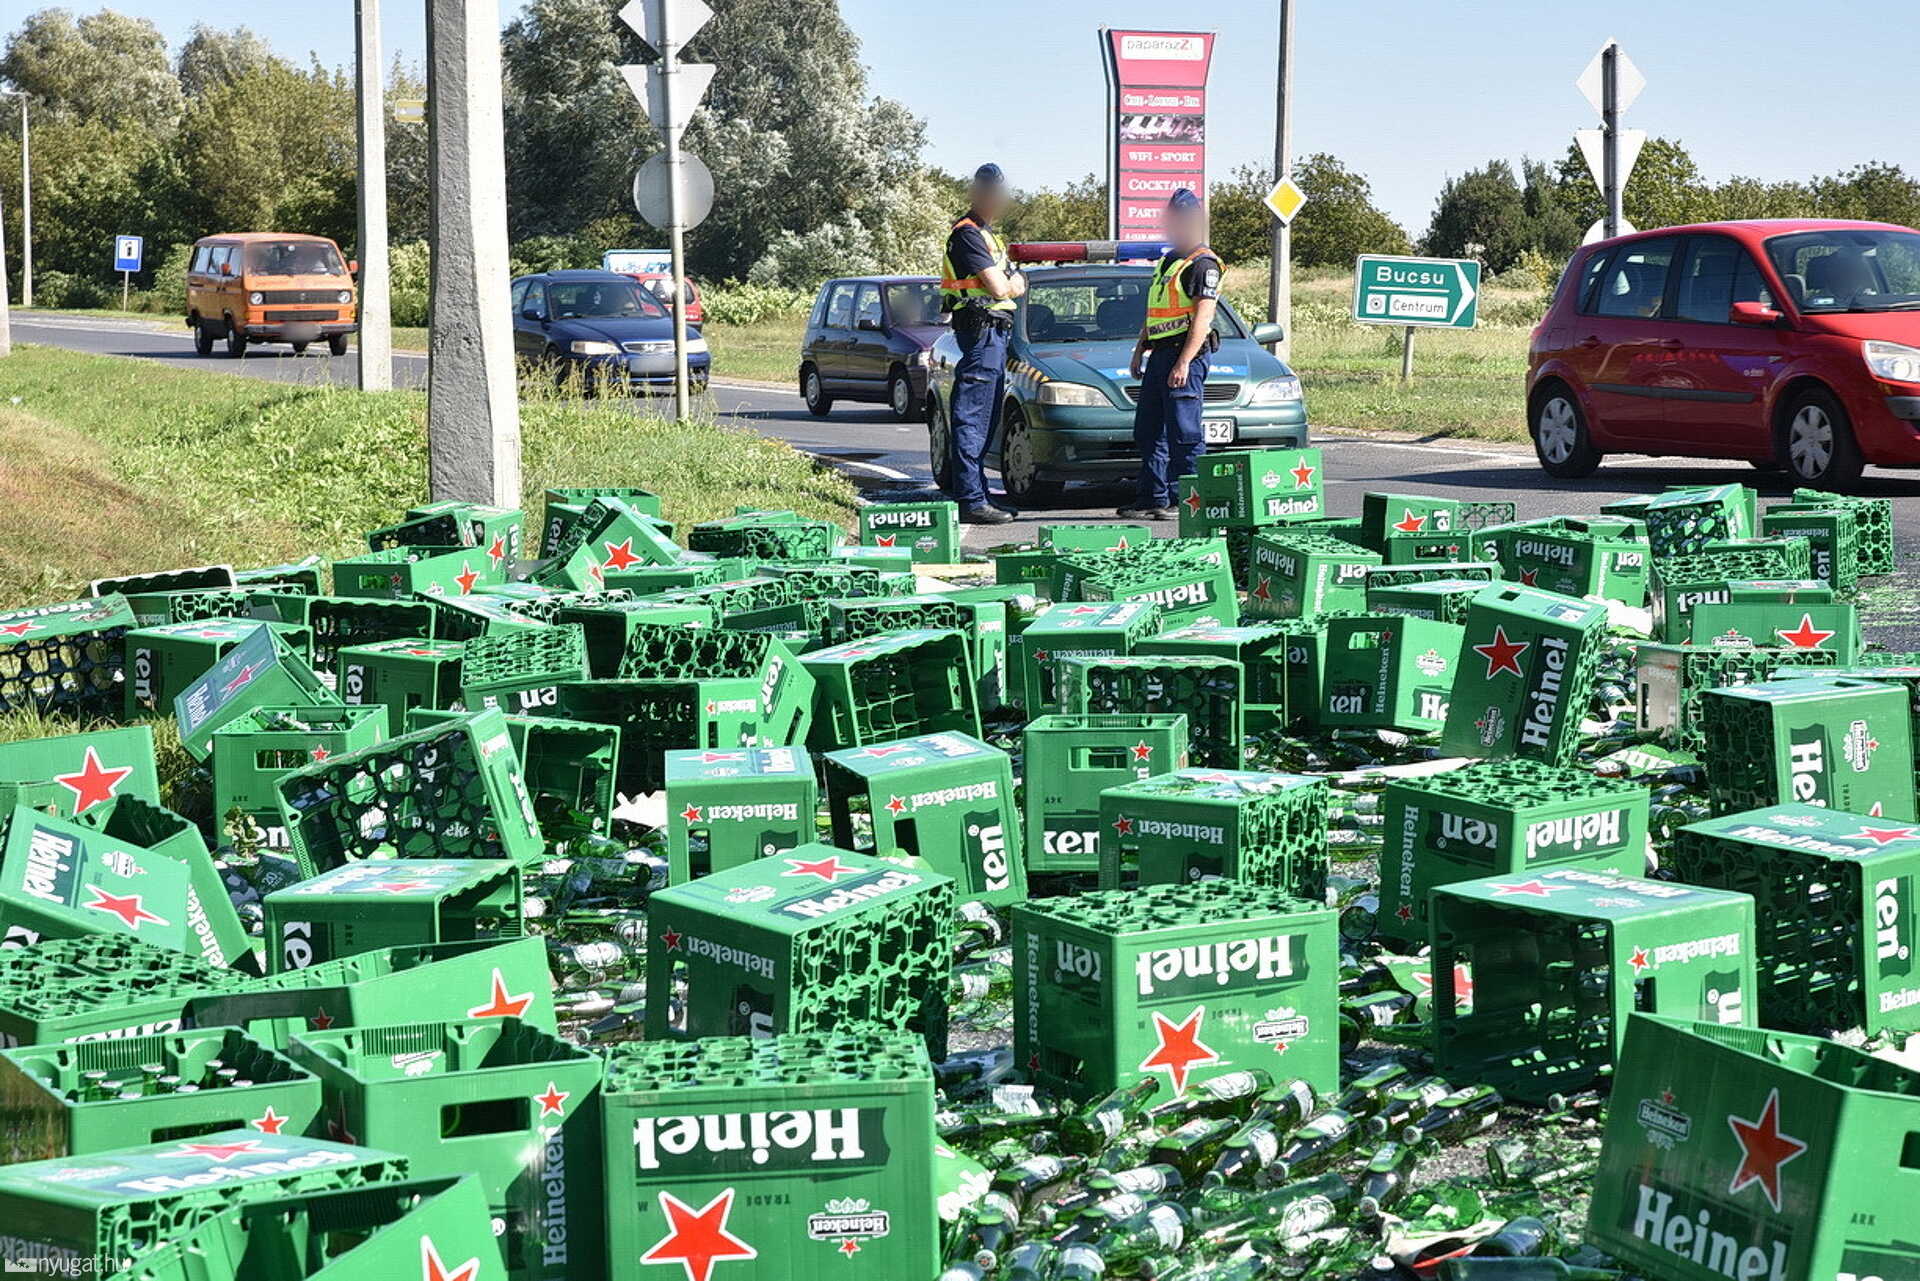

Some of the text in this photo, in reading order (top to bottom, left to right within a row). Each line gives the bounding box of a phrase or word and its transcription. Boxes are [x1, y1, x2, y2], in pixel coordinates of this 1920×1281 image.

[1128, 207, 1164, 218] PART
[1376, 266, 1445, 285] Bucsu
[1392, 299, 1445, 313] Centrum
[1375, 647, 1389, 713] Heineken
[911, 781, 997, 809] Heineken
[709, 804, 798, 822] Heineken
[1139, 820, 1224, 845] Heineken
[1400, 804, 1419, 897] Heineken
[688, 935, 775, 980] Heineken
[1654, 933, 1740, 965] Heineken
[1027, 933, 1041, 1042] Heineken
[542, 1123, 567, 1266] Heineken
[746, 1194, 792, 1207] TRADE
[812, 1217, 886, 1235] Heineken
[1851, 1213, 1876, 1226] ARK
